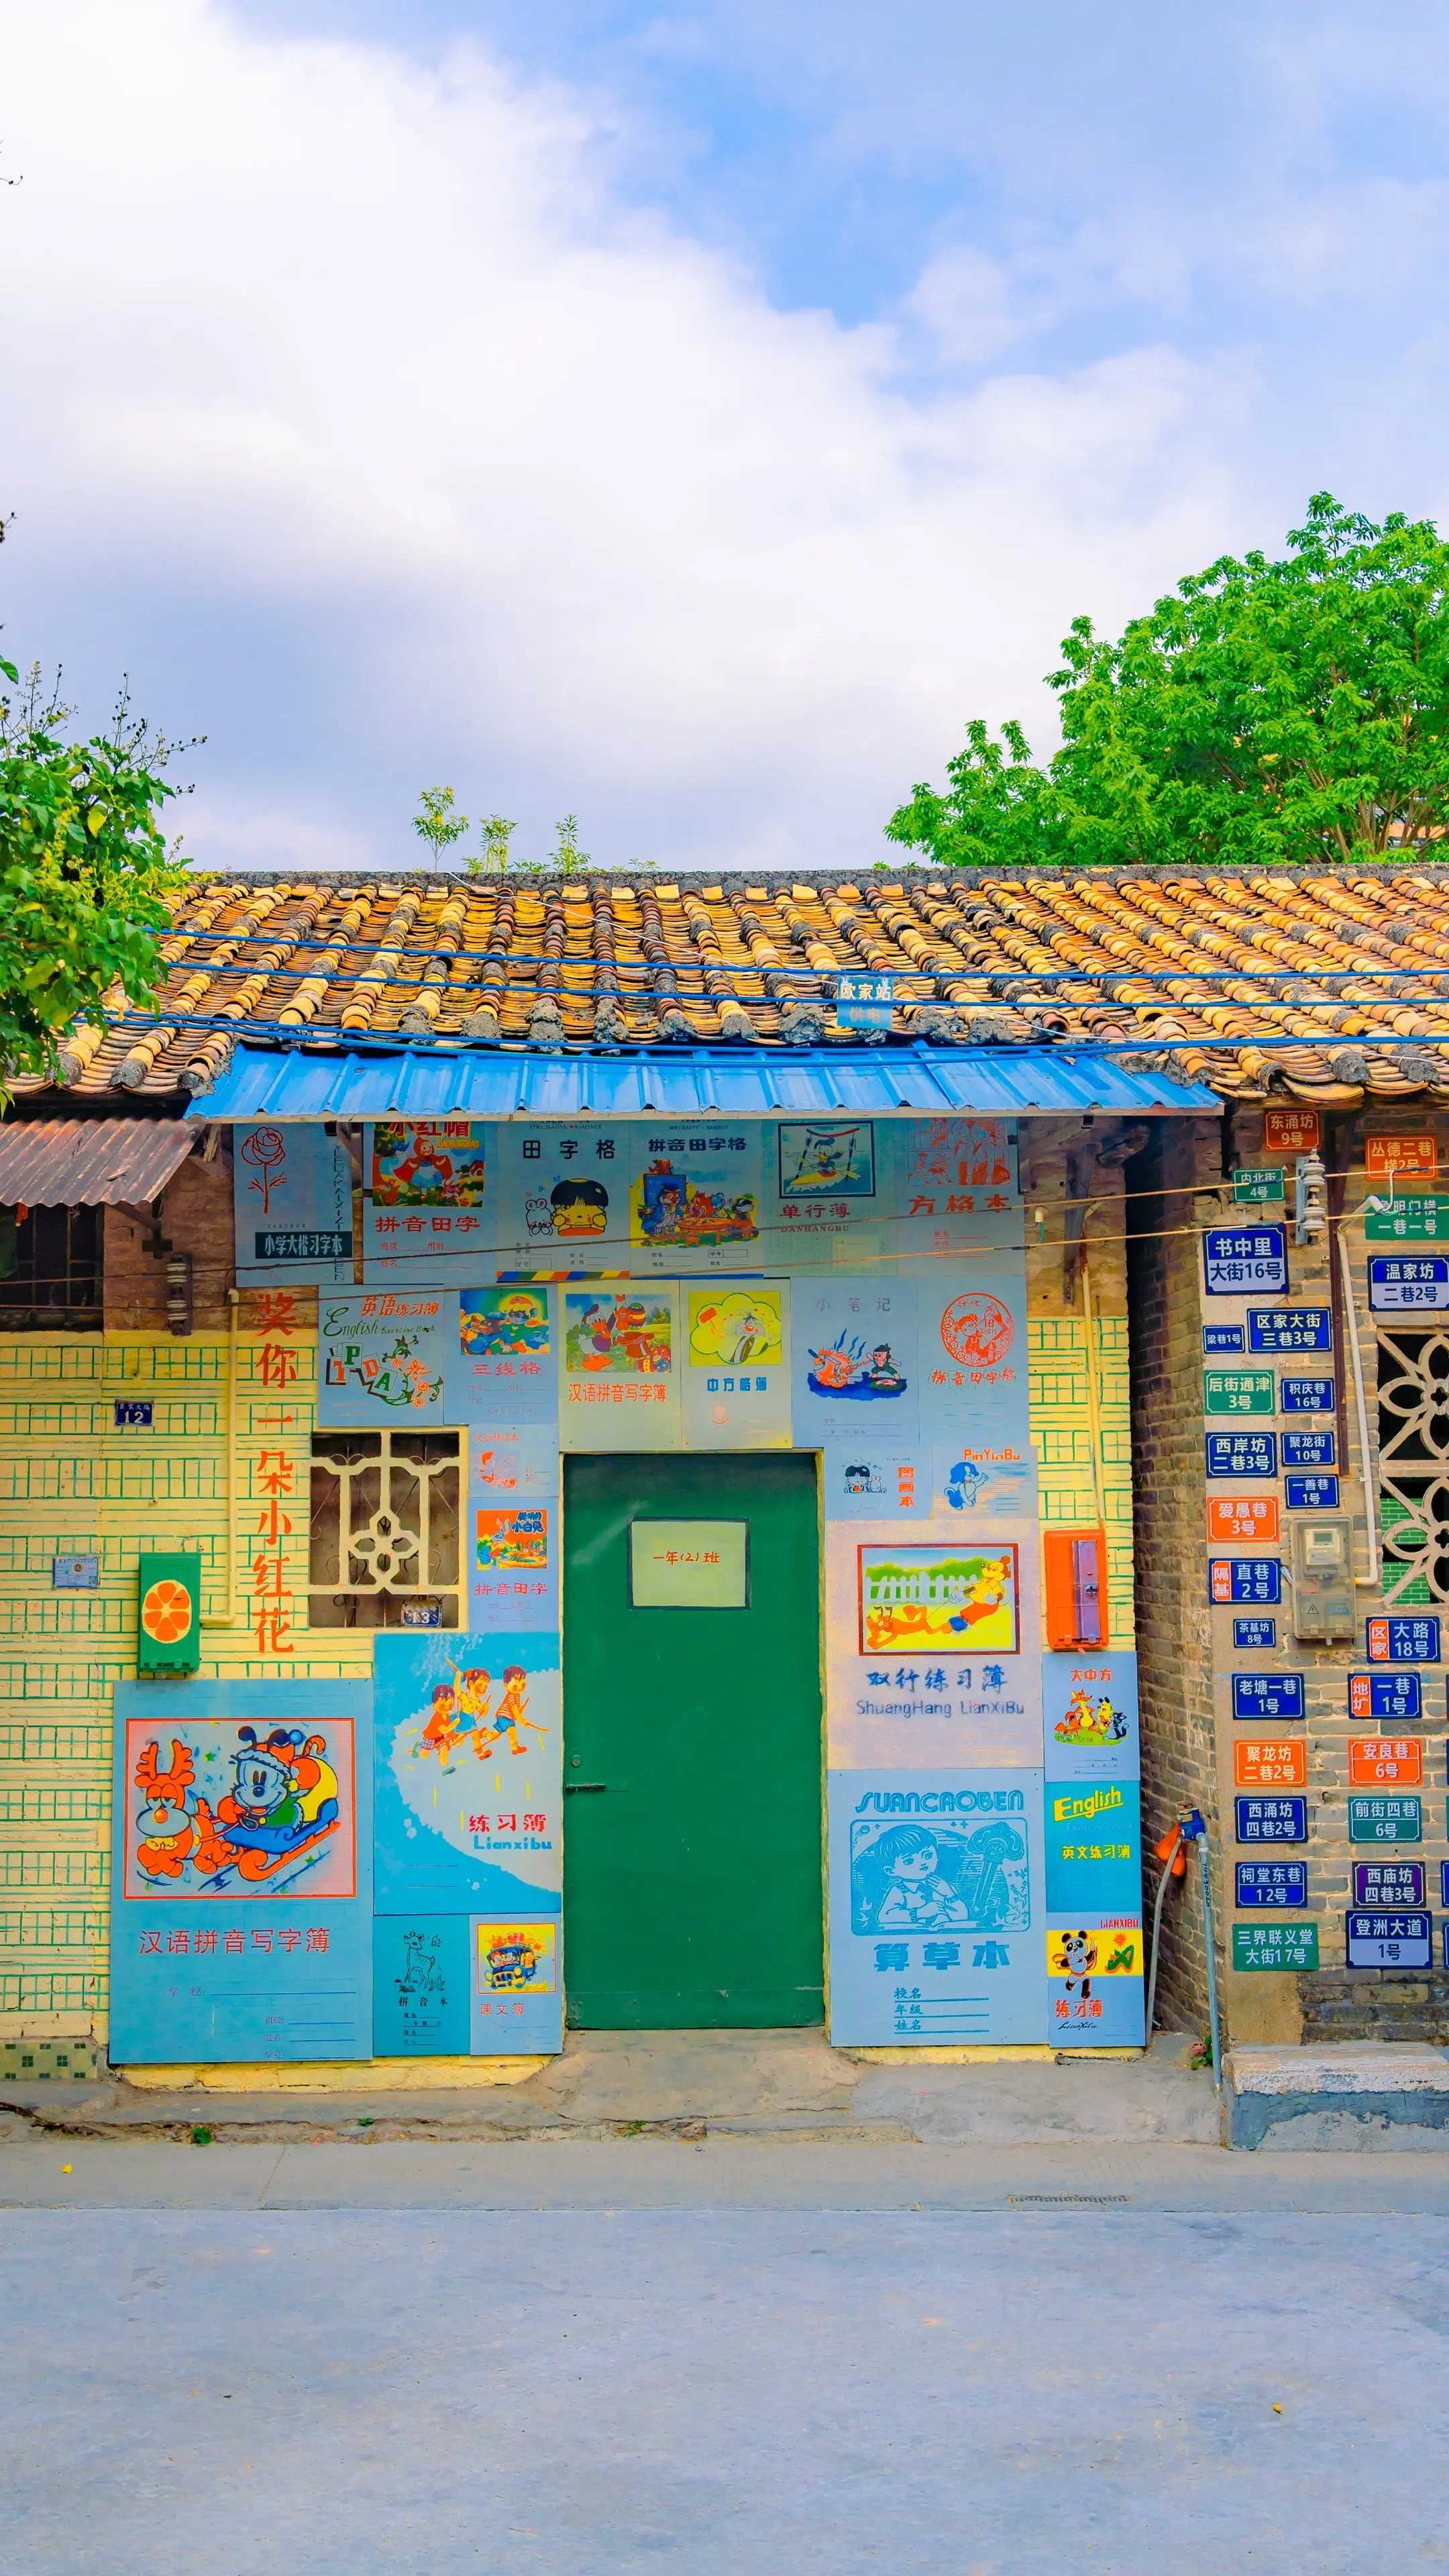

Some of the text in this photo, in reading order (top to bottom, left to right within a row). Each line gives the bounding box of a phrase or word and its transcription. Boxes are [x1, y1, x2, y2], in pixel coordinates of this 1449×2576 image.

[841, 983, 891, 1000] 欧家站
[1271, 1114, 1313, 1129] 东涌坊
[648, 1137, 747, 1152] 拼音田字格
[1281, 1132, 1304, 1146] 9号
[523, 1139, 616, 1160] 田字格
[1371, 1141, 1432, 1157] 丛德二巷
[1384, 1159, 1420, 1175] 横2号
[1250, 1187, 1268, 1197] 4号
[779, 1203, 851, 1219] 单行簿
[908, 1194, 1010, 1216] 方格本
[375, 1216, 481, 1234] 拼音田字
[780, 1225, 849, 1233] DANHANGBU
[1378, 1219, 1437, 1235] 一巷一号
[265, 1234, 342, 1256] 小学大楷习字本
[381, 1242, 444, 1250] 班级 组别
[1216, 1238, 1272, 1258] 书中里
[380, 1259, 397, 1267] 姓名
[1210, 1263, 1283, 1282] 大街16号
[1386, 1263, 1434, 1280] 温家坊
[1383, 1287, 1438, 1303] 二巷2号
[360, 1295, 439, 1318] 英语练习簿
[815, 1297, 890, 1312] 小笔记
[323, 1307, 378, 1340] English
[381, 1326, 414, 1334] Exercise
[985, 1320, 994, 1328] 田
[1256, 1313, 1321, 1330] 区家大街
[1206, 1333, 1242, 1345] 梁巷1号
[1262, 1331, 1317, 1347] 三巷3号
[344, 1346, 361, 1365] P
[362, 1358, 380, 1377] D
[374, 1372, 390, 1391] A
[472, 1360, 541, 1376] 三线格
[931, 1366, 1014, 1385] 拼音田字格
[707, 1377, 767, 1392] 中方格簿
[1209, 1377, 1271, 1392] 后街通津
[1289, 1383, 1326, 1395] 积庆巷
[568, 1383, 666, 1403] 汉语拼音写字簿
[1229, 1395, 1252, 1409] 3号
[1295, 1396, 1322, 1408] 16号
[125, 1411, 144, 1424] 12
[1216, 1438, 1267, 1454] 西岸坊
[1289, 1436, 1326, 1448] 聚龙街
[963, 1448, 1020, 1460] PinYinBu
[1295, 1450, 1322, 1462] 10号
[1214, 1455, 1270, 1470] 二巷3号
[252, 1292, 297, 1653] 奖你一朵小红花
[898, 1466, 916, 1507] 图画本
[1292, 1479, 1329, 1491] 一善巷
[1302, 1493, 1321, 1505] 1号
[1219, 1502, 1268, 1519] 爱愚巷
[512, 1521, 544, 1533] 小白兔
[1232, 1520, 1257, 1536] 3号
[1237, 1564, 1269, 1580] 直巷
[475, 1582, 548, 1596] 拼音田字
[1214, 1568, 1230, 1596] 隔基
[1242, 1582, 1269, 1598] 2号
[412, 1612, 430, 1623] 13
[1239, 1622, 1269, 1633] 茶基坊
[1394, 1622, 1429, 1639] 大路
[1247, 1634, 1263, 1644] 8号
[1372, 1626, 1387, 1655] 区家
[1395, 1641, 1429, 1657] 18号
[865, 1664, 1008, 1694] 双行练习簿
[1070, 1669, 1112, 1682] 大中方
[1239, 1680, 1297, 1695] 老塘一巷
[1377, 1678, 1410, 1695] 一巷
[856, 1700, 1024, 1718] ShuangHang LianXiBu
[1258, 1699, 1279, 1715] 1号
[1383, 1697, 1407, 1715] 1号
[1247, 1746, 1292, 1762] 聚龙坊
[1363, 1743, 1409, 1758] 安良巷
[1244, 1764, 1295, 1781] 二巷2号
[1375, 1763, 1399, 1780] 6号
[855, 1790, 1024, 1813] SUANCAOBEN
[1054, 1786, 1124, 1821] English
[1356, 1801, 1417, 1817] 前街四巷
[1248, 1802, 1293, 1818] 西涌坊
[469, 1814, 547, 1833] 练习簿
[1246, 1821, 1296, 1837] 四巷2号
[1375, 1822, 1398, 1839] 6号
[474, 1835, 552, 1849] Lianxibu
[1062, 1845, 1130, 1860] 英文练习簿
[1241, 1868, 1300, 1883] 祠堂东巷
[1367, 1868, 1413, 1884] 西庙坊
[1256, 1888, 1287, 1904] 12号
[1364, 1886, 1416, 1902] 四巷3号
[1100, 1919, 1138, 1929] LIANXIBU
[1356, 1919, 1421, 1936] 登洲大道
[139, 1927, 330, 1954] 汉语拼音写字簿
[1238, 1929, 1313, 1945] 三界联义堂
[874, 1941, 1010, 1972] 算草本
[1246, 1948, 1307, 1964] 大街17号
[1378, 1943, 1401, 1961] 1号
[398, 1996, 448, 2006] 拼音本
[894, 1987, 922, 1999] 校名
[480, 2002, 524, 2015] 课文簿
[894, 2004, 923, 2016] 年级
[1056, 1999, 1103, 2018] 练习簿
[894, 2019, 921, 2031] 姓名
